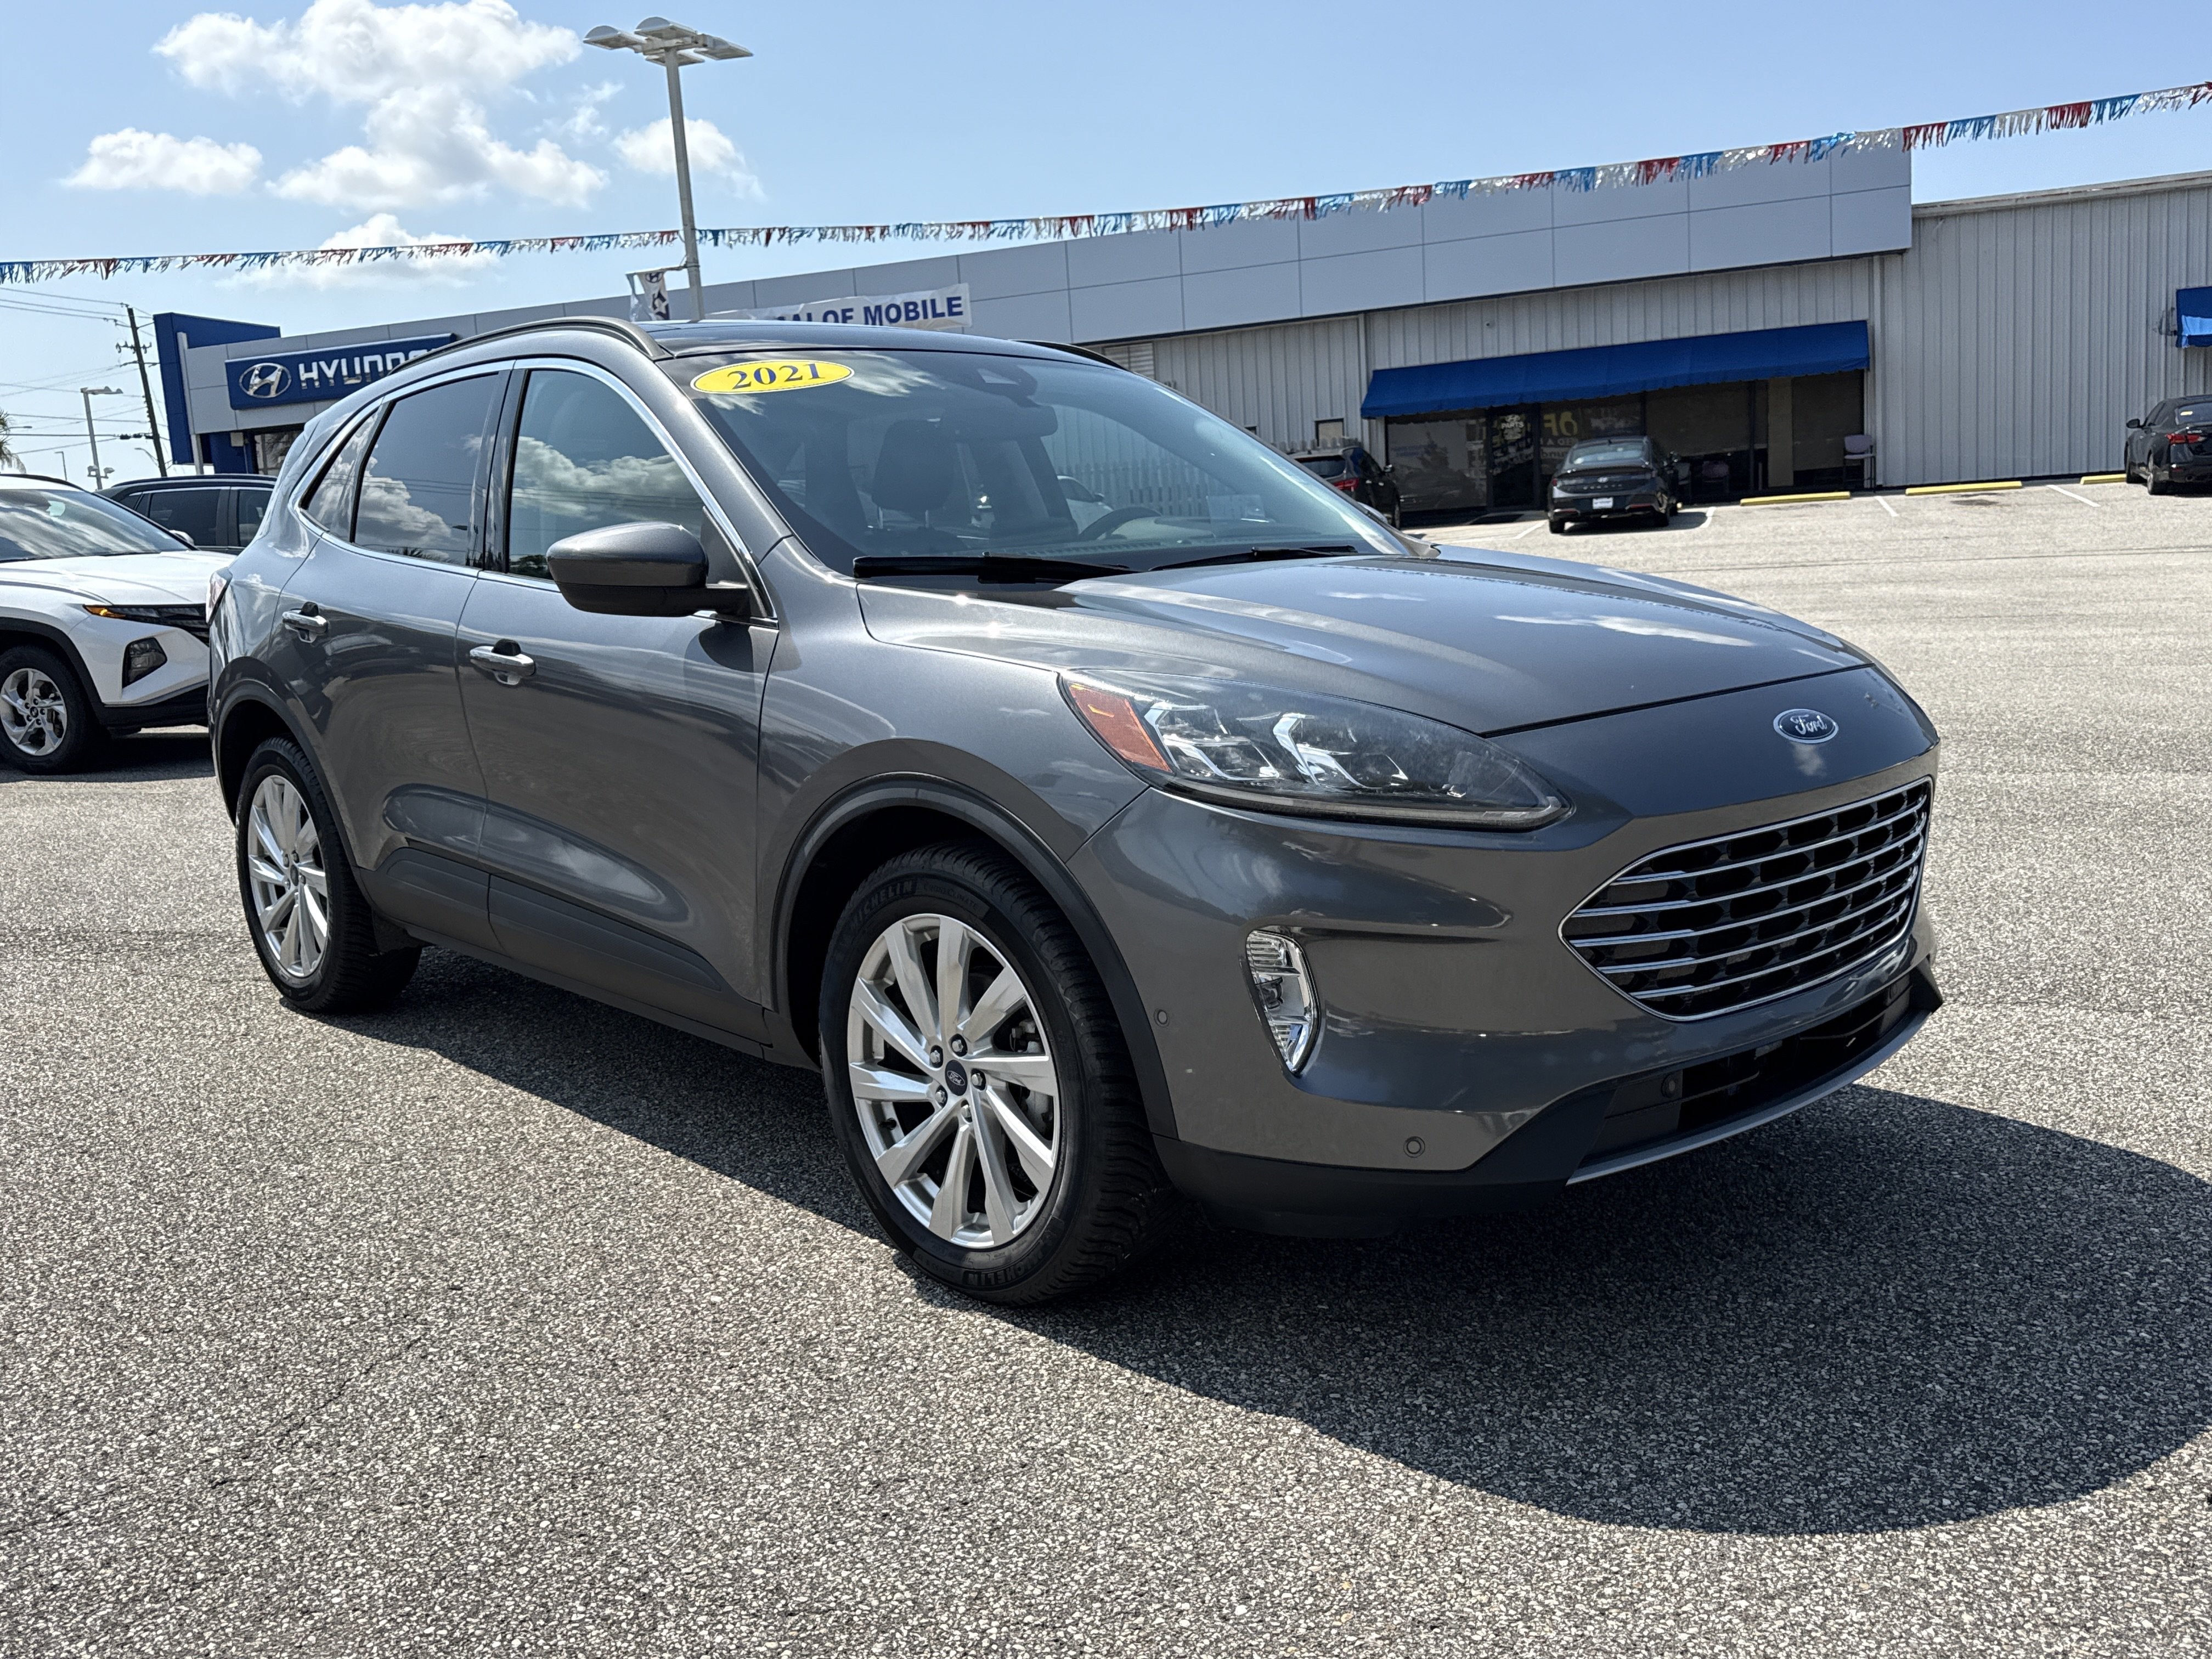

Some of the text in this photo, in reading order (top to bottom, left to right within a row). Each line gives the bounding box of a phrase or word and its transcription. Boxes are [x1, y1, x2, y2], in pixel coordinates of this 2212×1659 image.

[864, 296, 963, 326] MOBILE
[298, 348, 438, 390] HYUND
[727, 363, 825, 390] 2021
[1790, 714, 1827, 735] Ford
